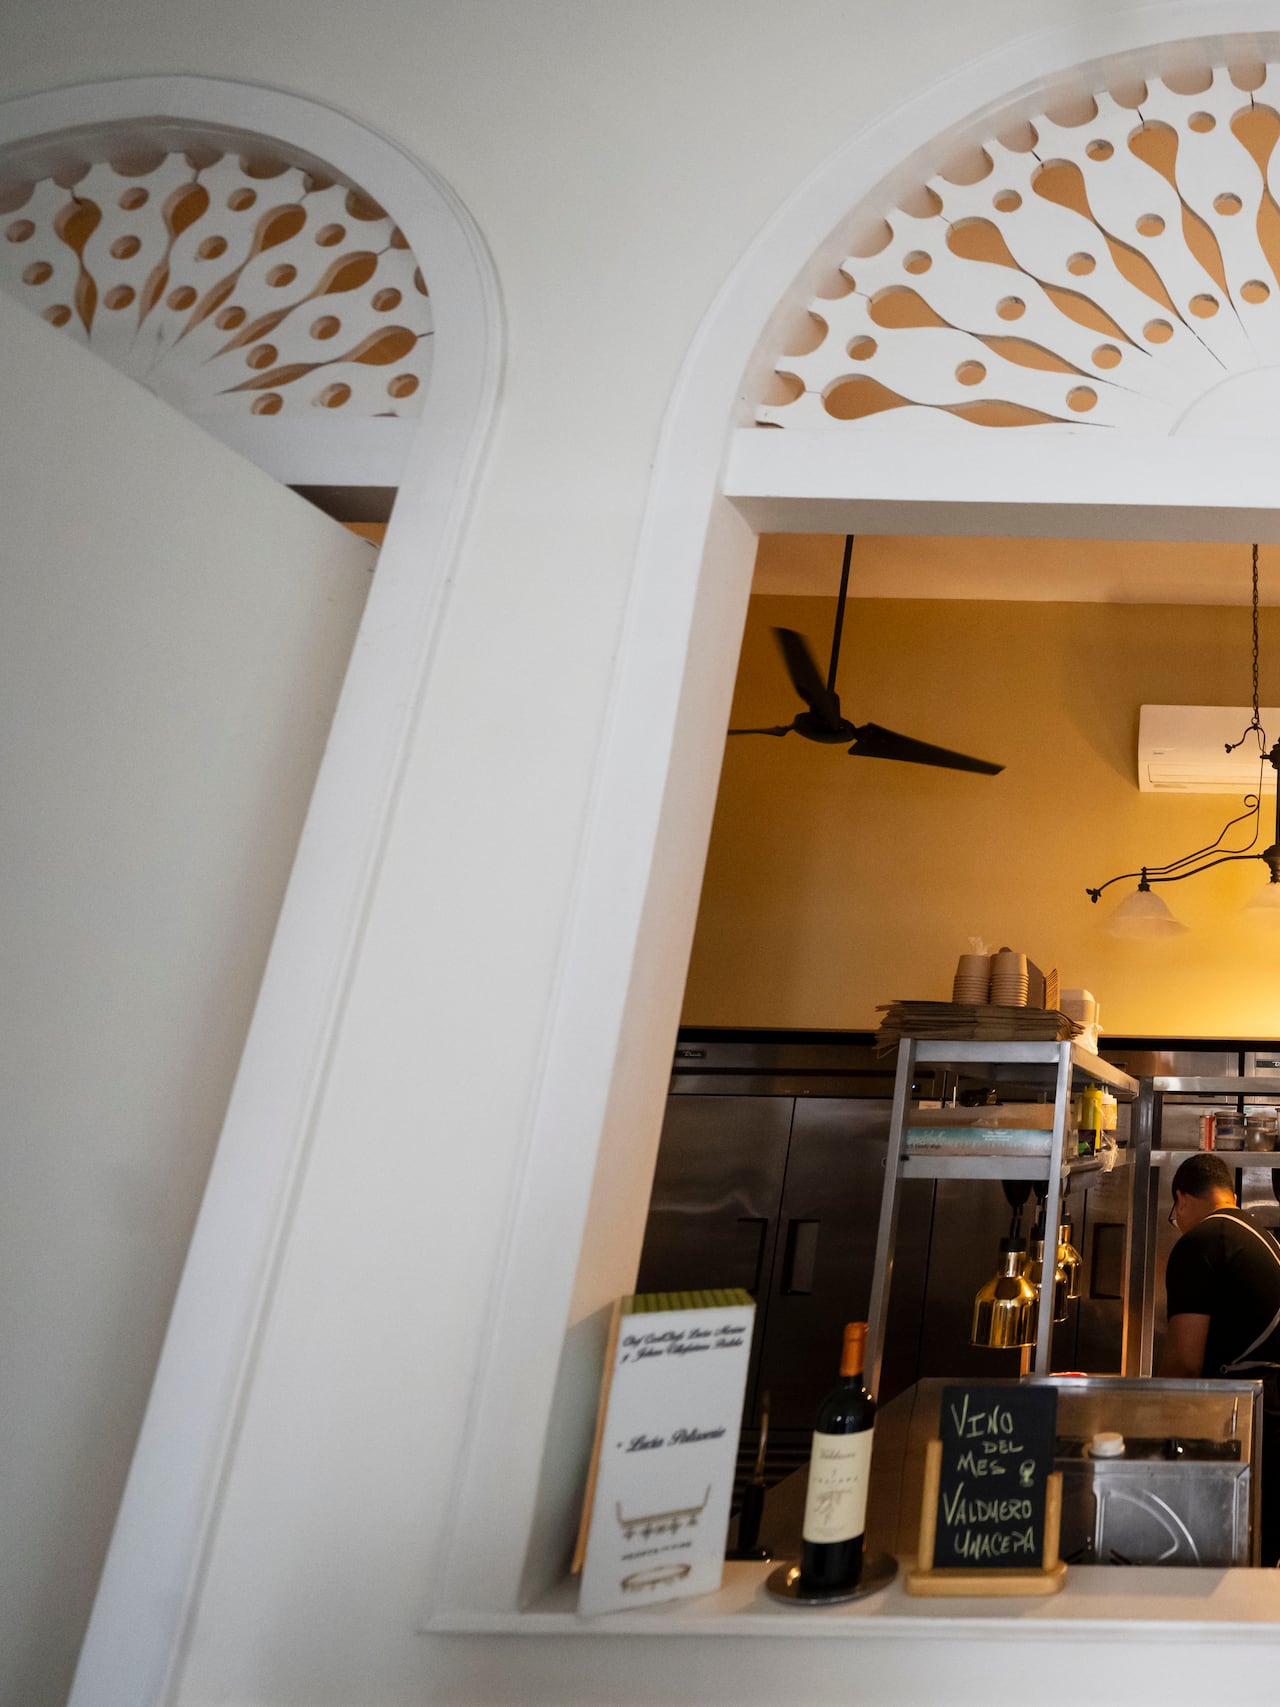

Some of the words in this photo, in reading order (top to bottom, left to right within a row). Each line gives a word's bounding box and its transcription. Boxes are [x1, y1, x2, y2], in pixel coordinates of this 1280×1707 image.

[951, 1393, 1014, 1439] VINO
[981, 1440, 1024, 1454] DEL
[957, 1450, 1006, 1477] MES
